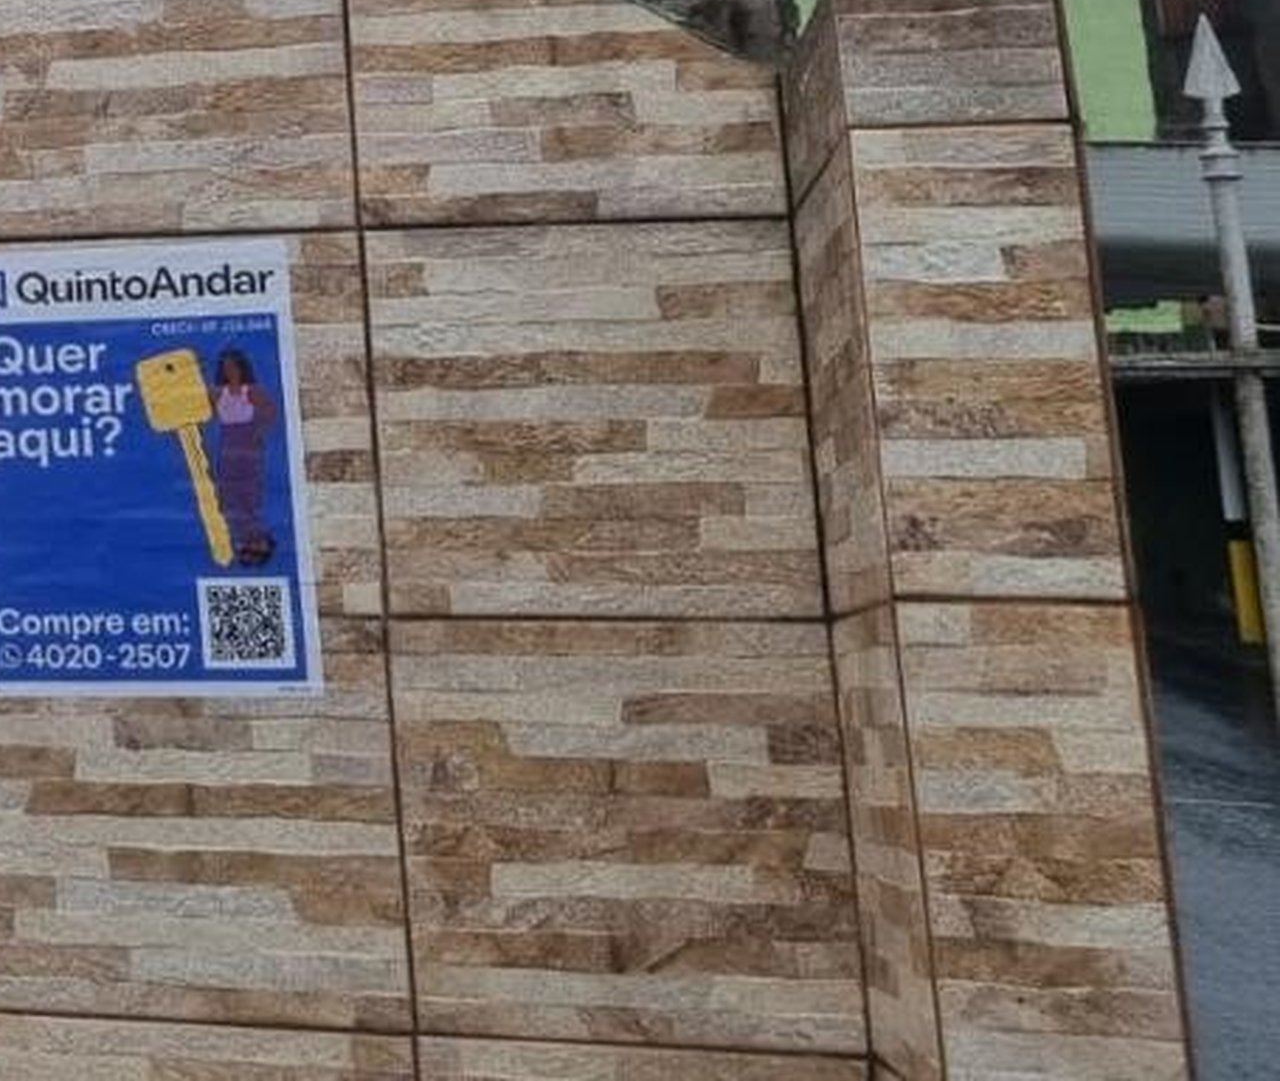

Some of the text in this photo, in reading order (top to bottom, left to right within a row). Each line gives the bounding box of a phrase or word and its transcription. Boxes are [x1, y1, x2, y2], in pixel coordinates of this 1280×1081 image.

[15, 264, 275, 306] QuintoAndar
[131, 610, 191, 635] em:
[26, 643, 191, 670] 4020-2507
